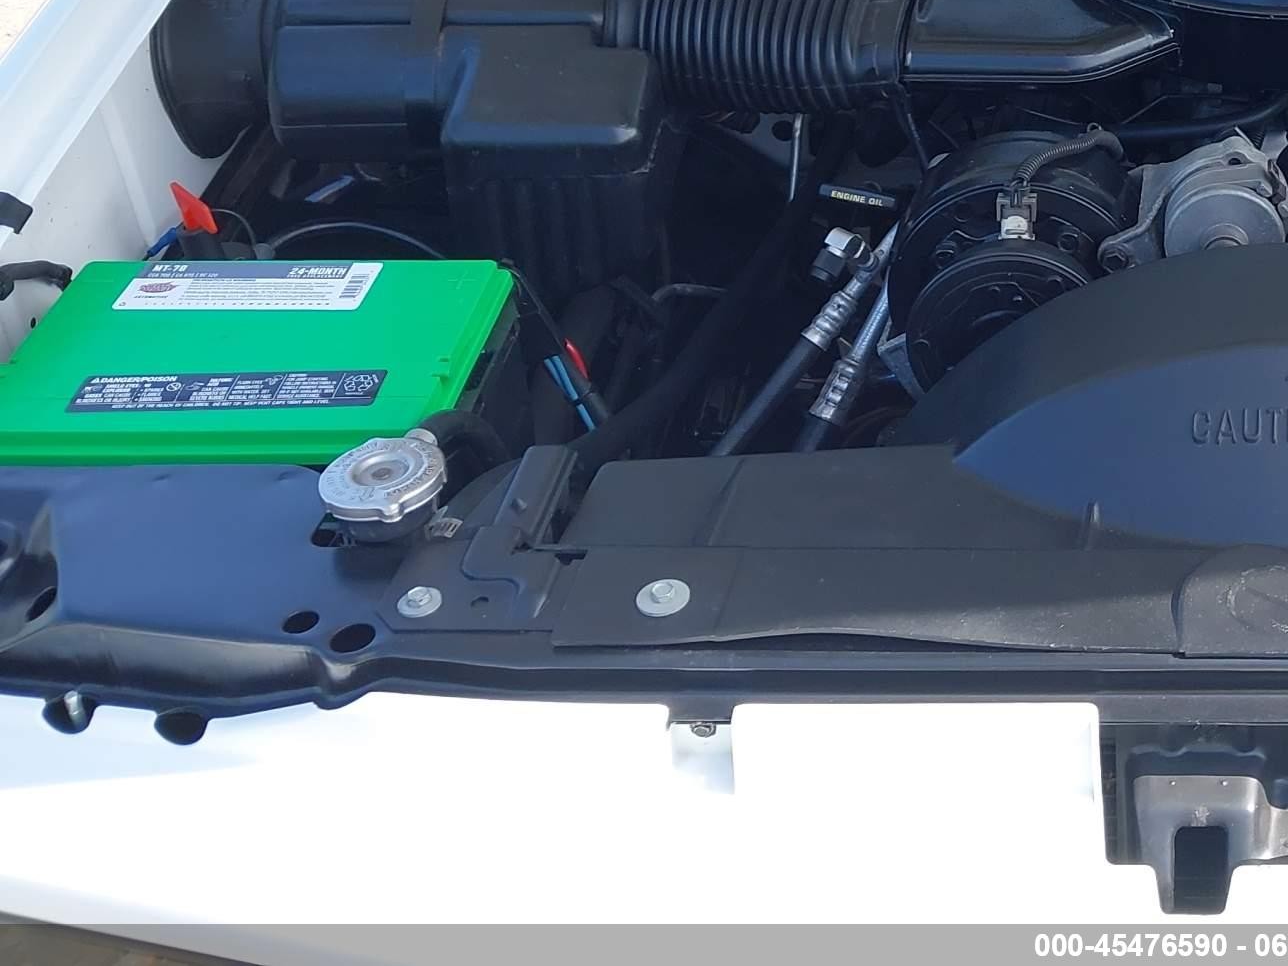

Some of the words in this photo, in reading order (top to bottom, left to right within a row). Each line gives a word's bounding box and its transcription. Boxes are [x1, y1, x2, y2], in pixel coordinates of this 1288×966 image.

[831, 190, 866, 204] ENGINE
[868, 197, 884, 207] OIL
[289, 267, 348, 275] 24-MONTH
